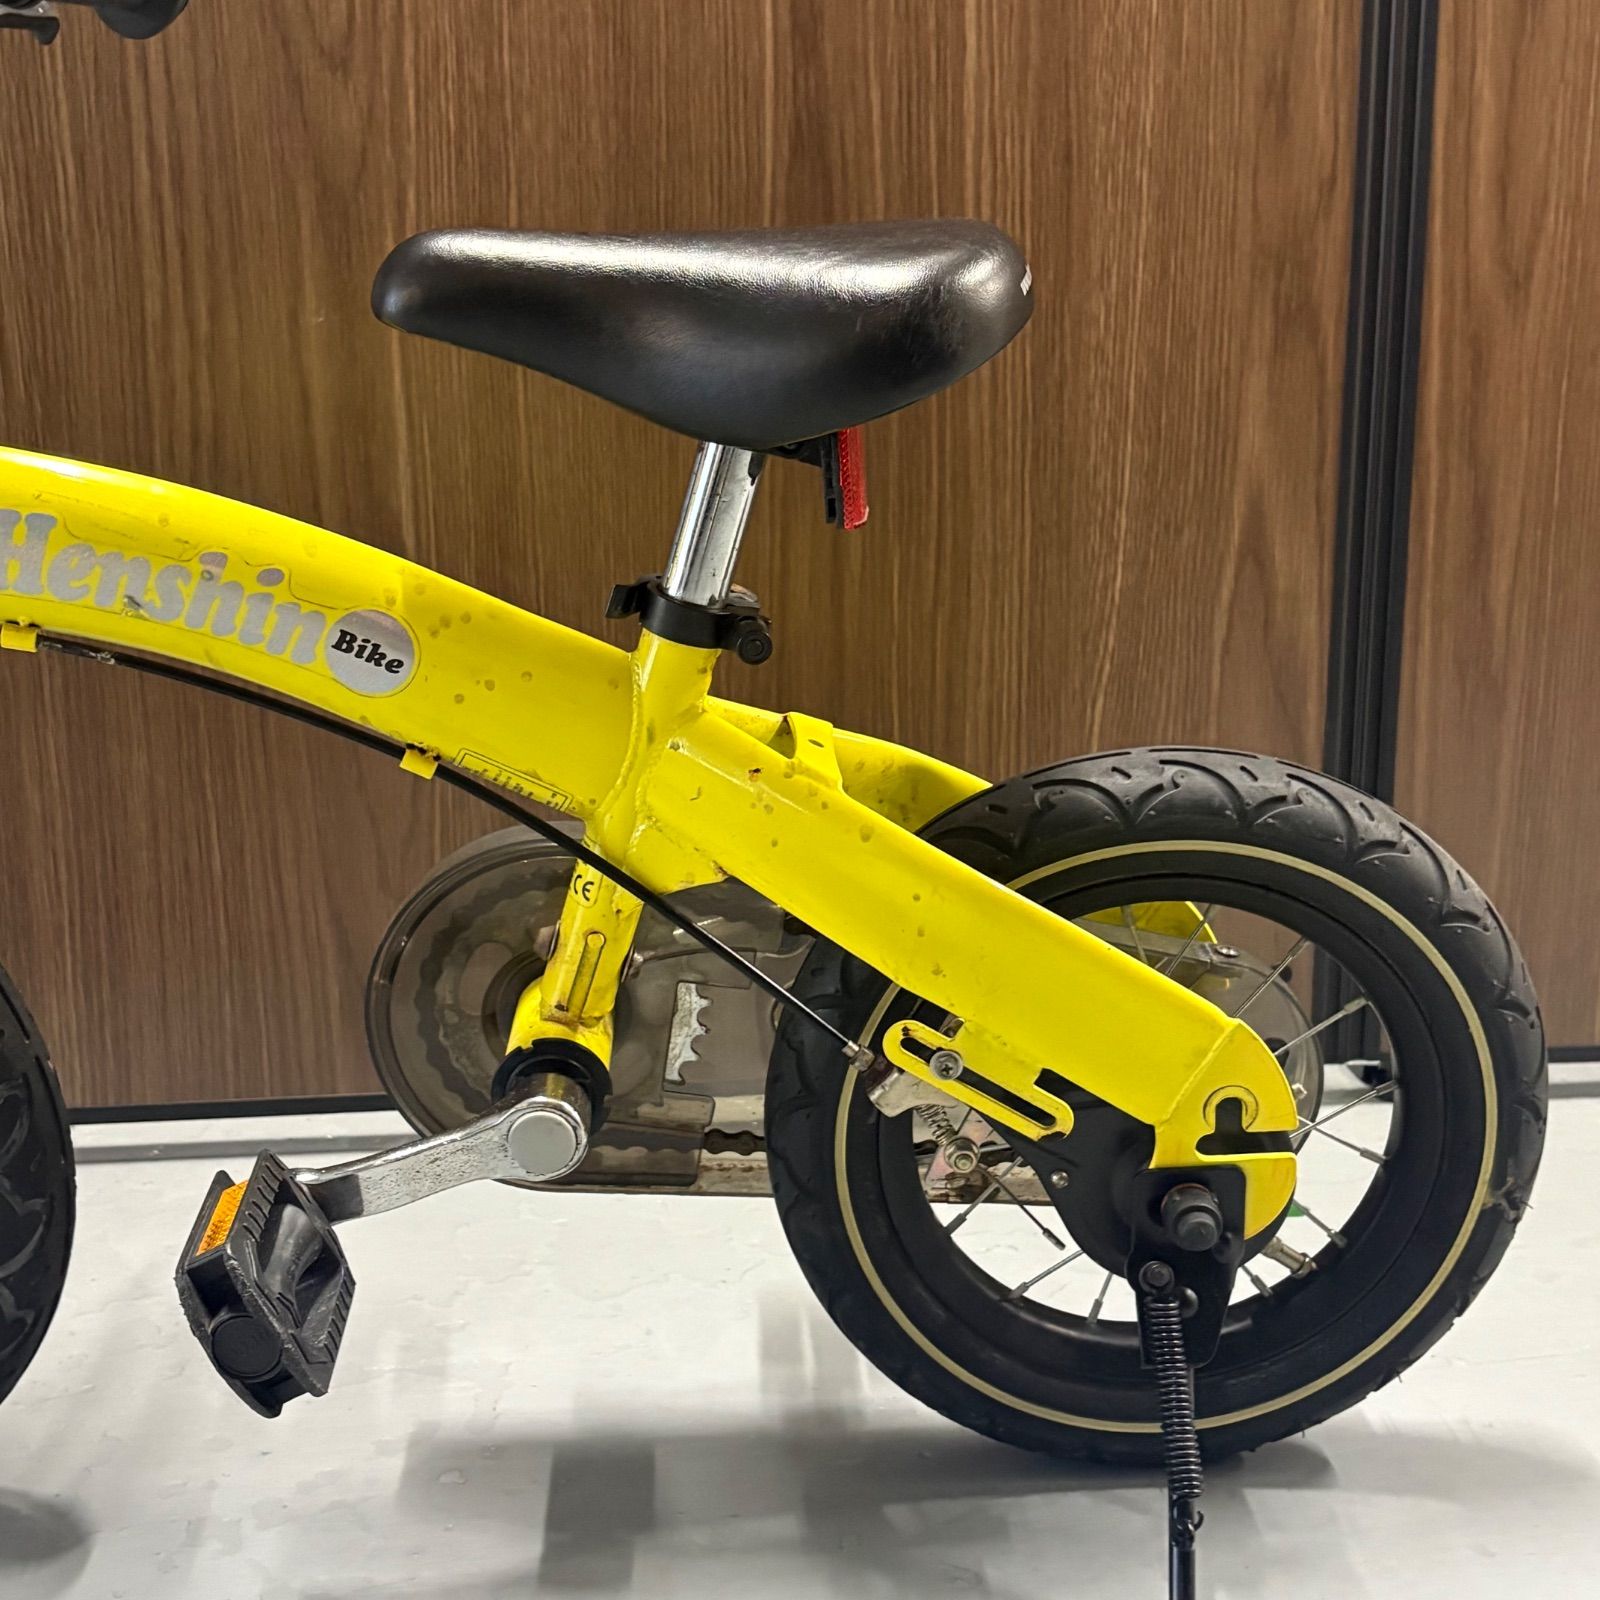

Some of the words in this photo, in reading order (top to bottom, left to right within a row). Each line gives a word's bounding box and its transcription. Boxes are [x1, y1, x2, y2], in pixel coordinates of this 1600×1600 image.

[0, 508, 326, 664] Henshin
[331, 629, 405, 674] Bike
[573, 873, 595, 902] CE
